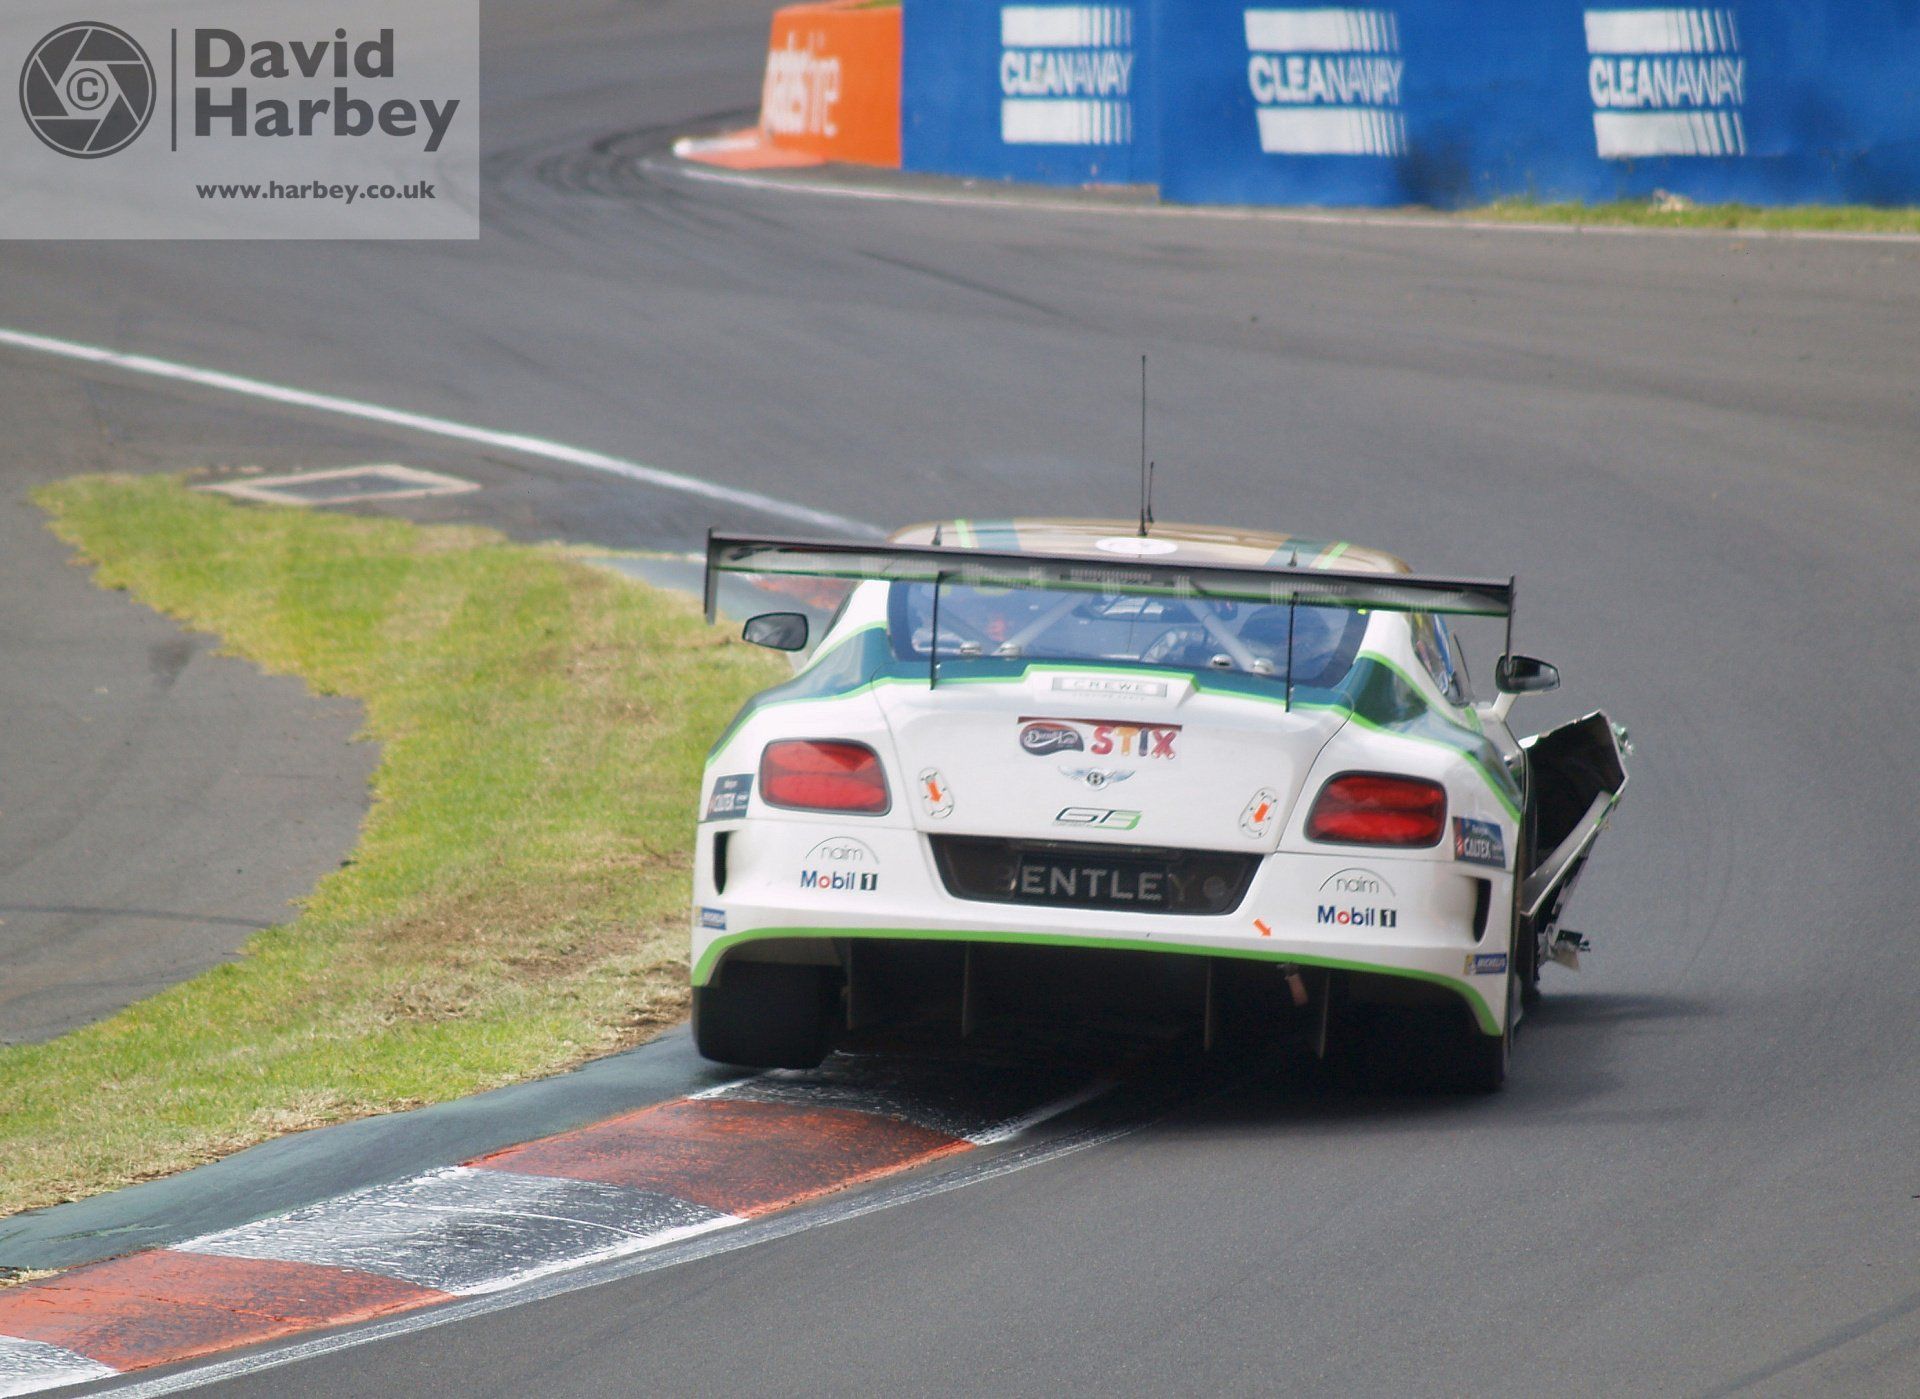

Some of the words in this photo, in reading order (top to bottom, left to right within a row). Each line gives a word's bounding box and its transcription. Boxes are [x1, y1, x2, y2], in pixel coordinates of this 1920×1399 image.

[1001, 51, 1133, 97] CLEANAWAY
[1248, 55, 1402, 107] CLEANAWAY
[1588, 57, 1745, 108] CLEANAWAY
[1091, 725, 1177, 760] STIX
[800, 870, 856, 890] Mobil
[1317, 905, 1376, 927] Mobil
